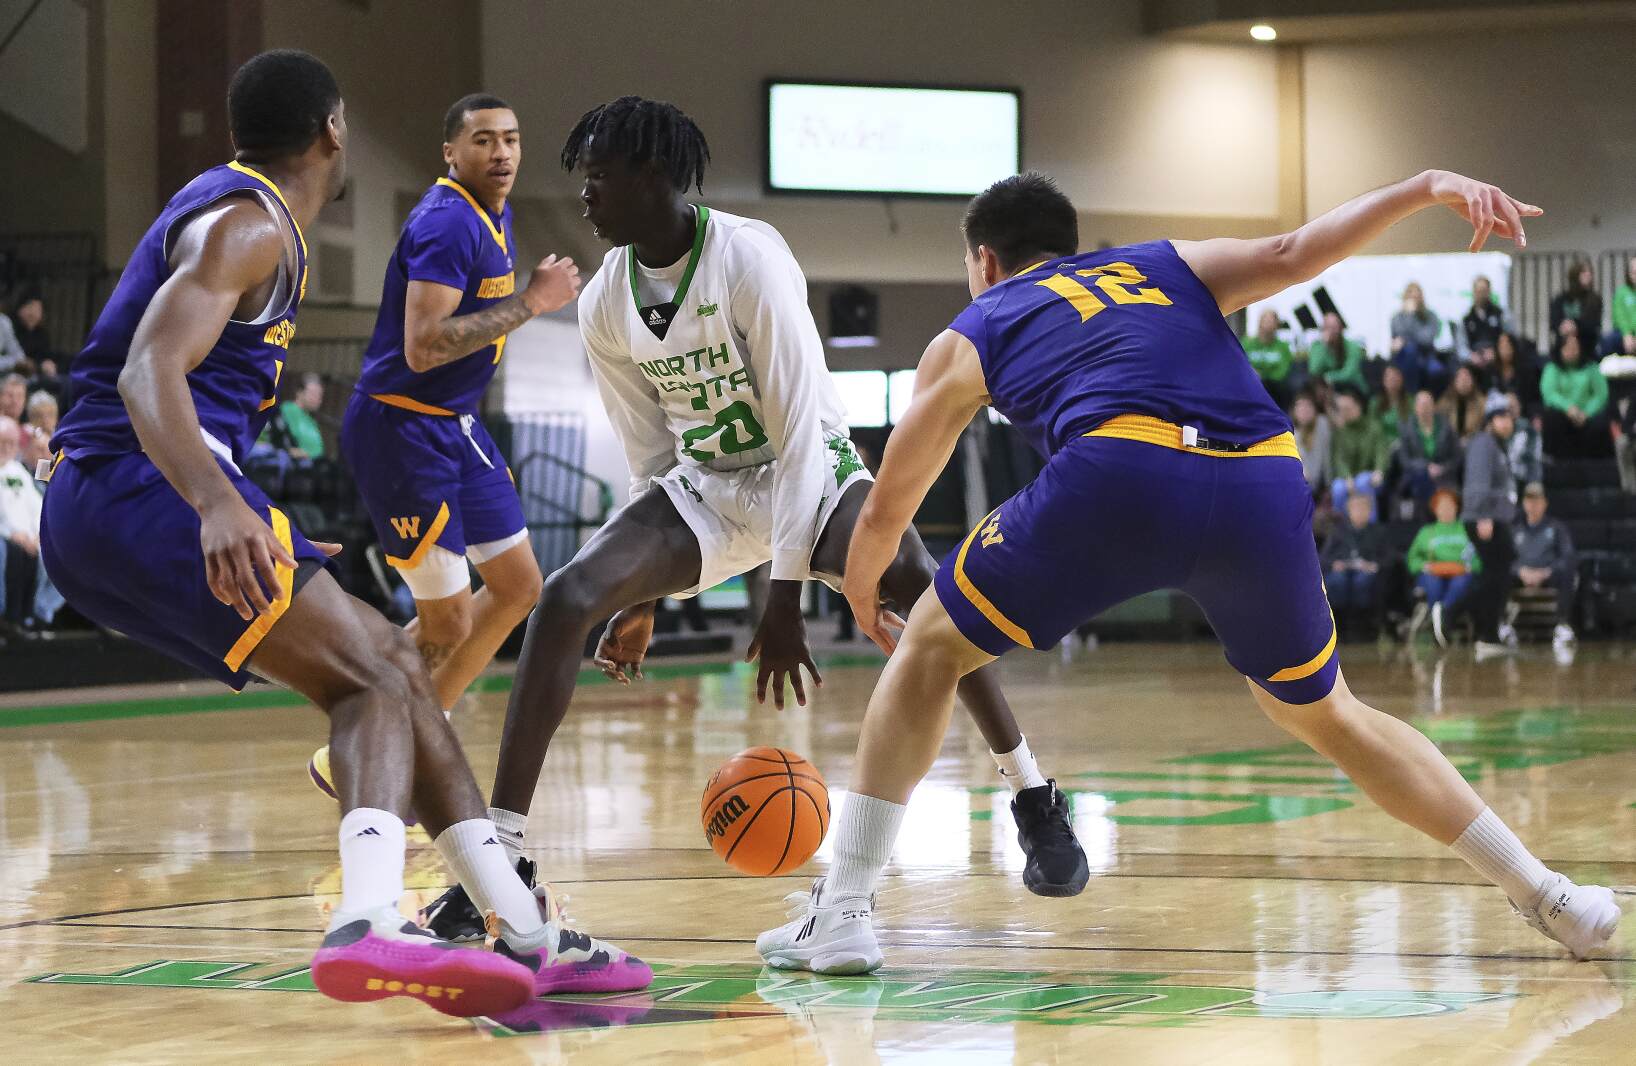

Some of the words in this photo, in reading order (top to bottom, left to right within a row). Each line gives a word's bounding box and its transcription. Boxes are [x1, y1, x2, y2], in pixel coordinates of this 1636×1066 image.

[1034, 261, 1174, 324] 12
[638, 342, 730, 378] NORTH
[681, 400, 769, 462] 20
[390, 515, 420, 539] W
[981, 512, 1005, 549] W
[366, 978, 465, 1000] BOOST
